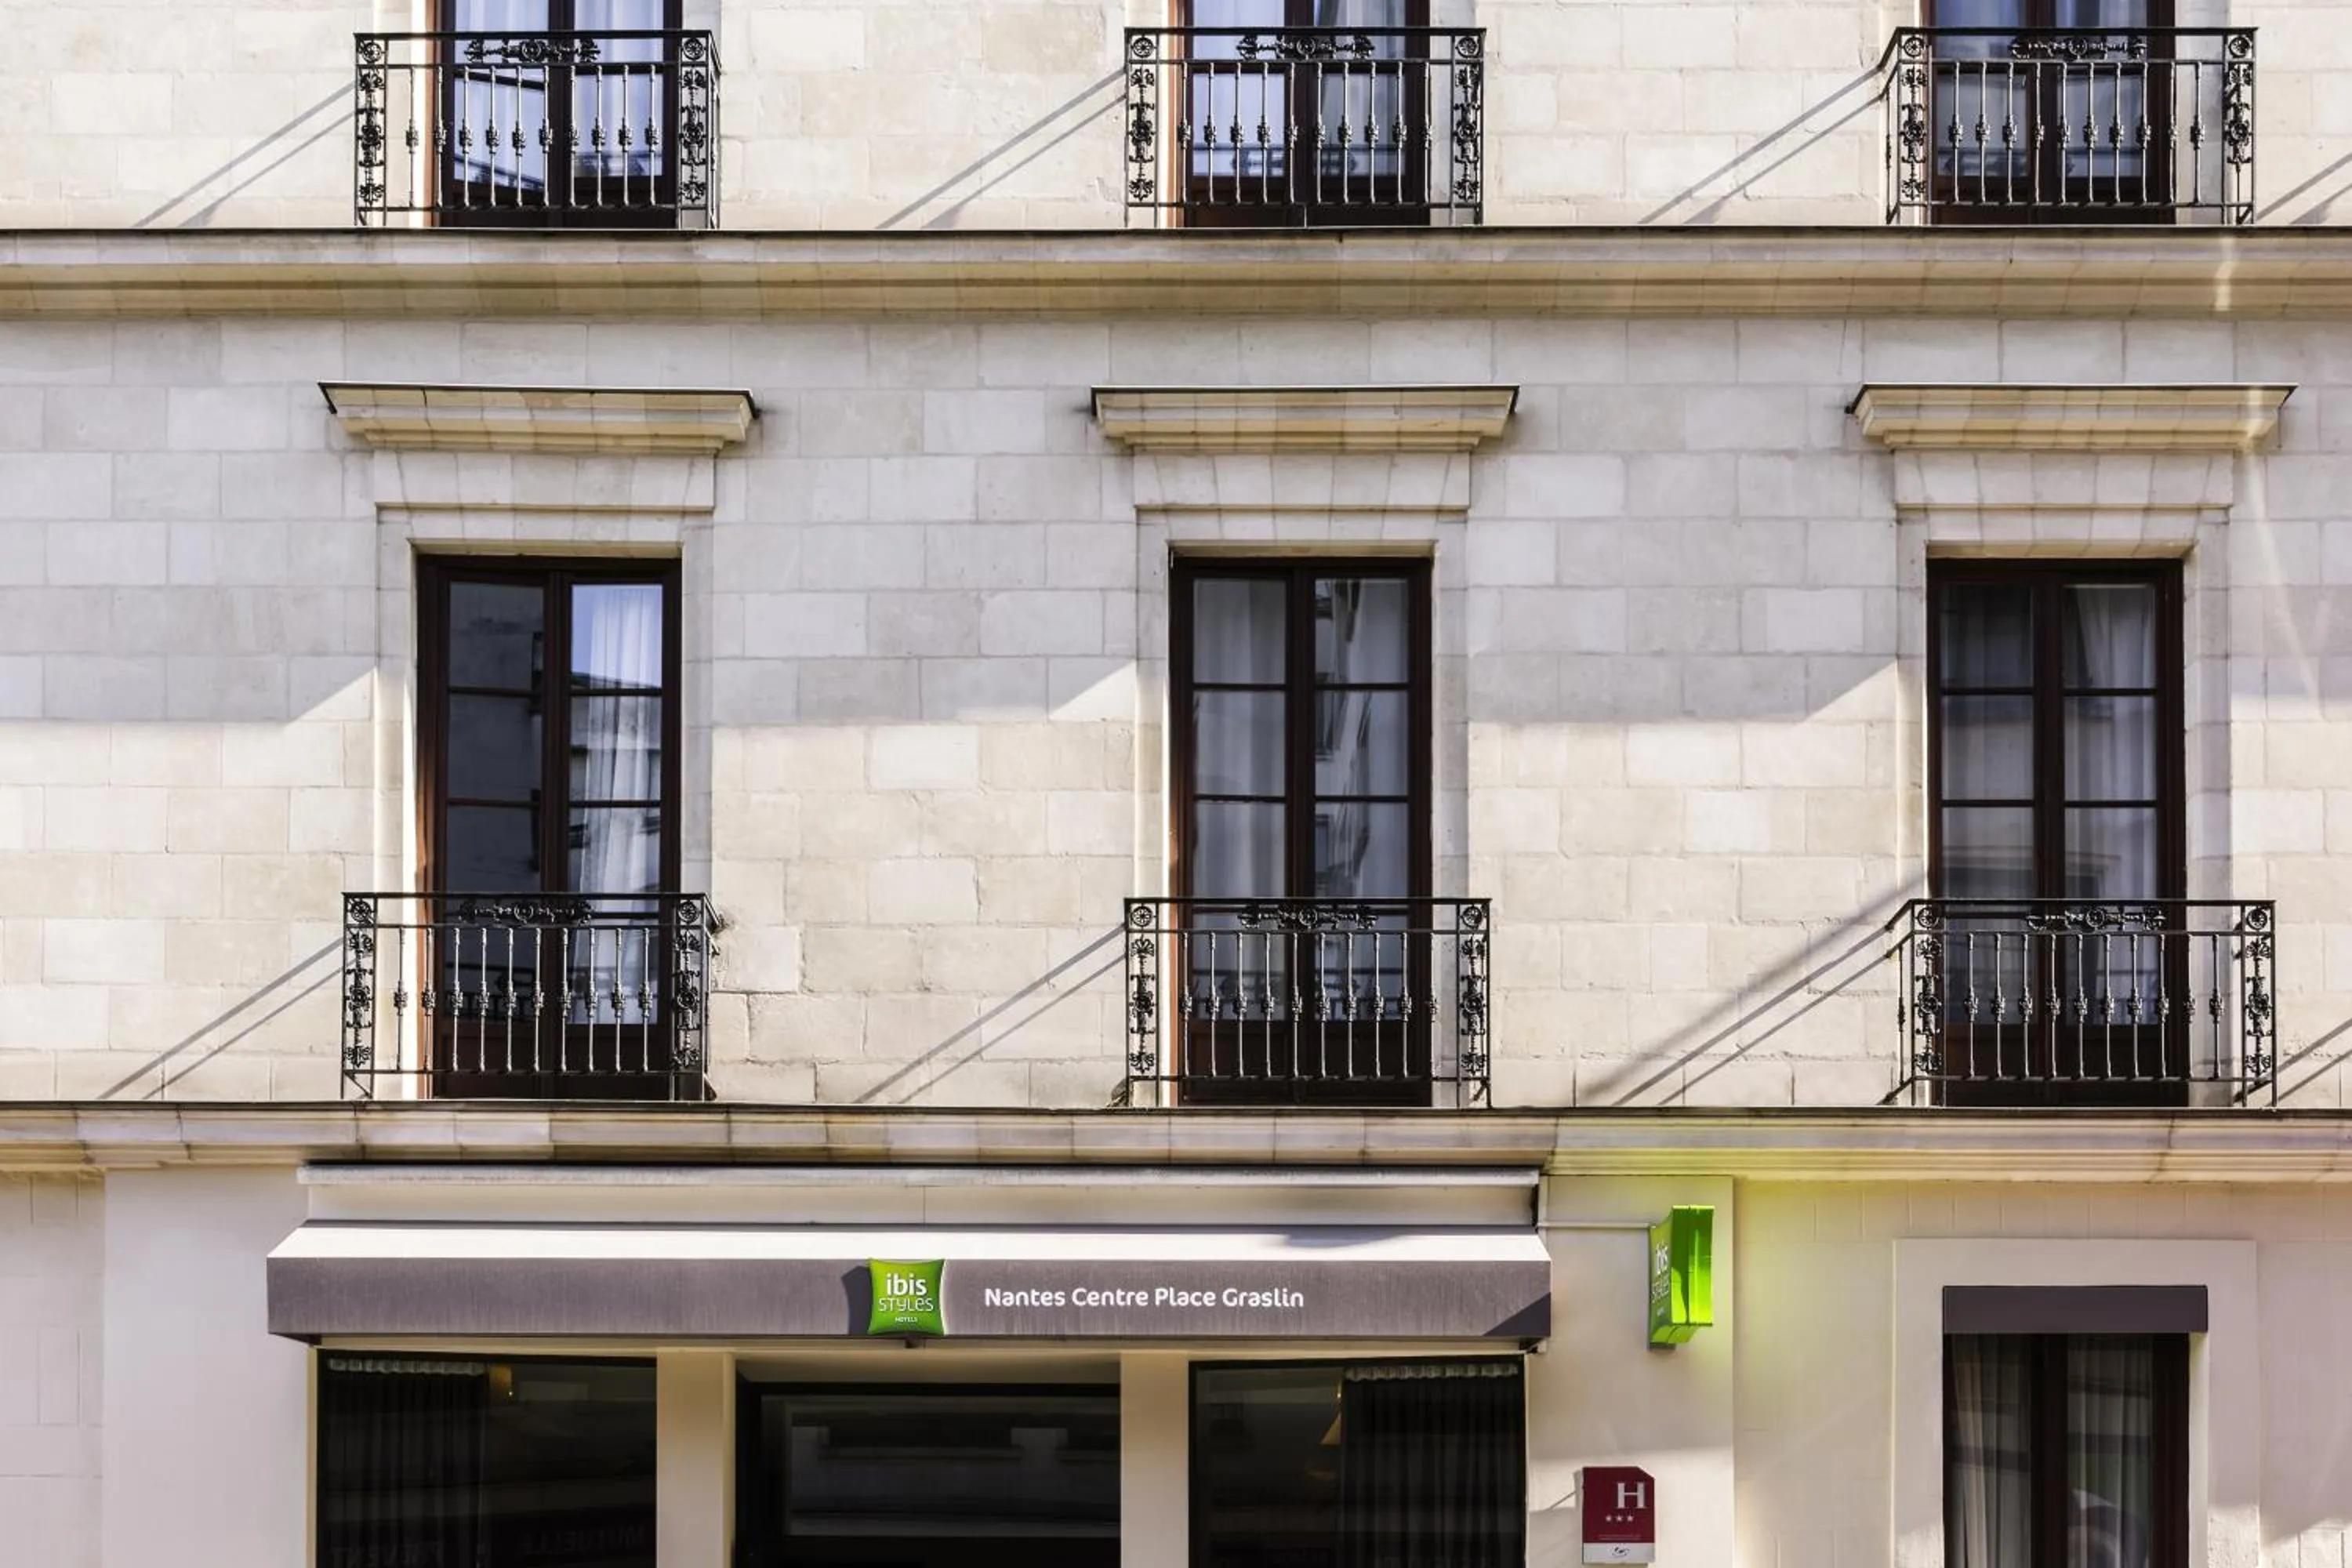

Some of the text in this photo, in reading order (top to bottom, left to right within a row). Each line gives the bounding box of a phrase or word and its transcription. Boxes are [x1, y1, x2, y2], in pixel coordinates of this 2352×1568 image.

[886, 1272, 927, 1296] ibis
[984, 1287, 1305, 1308] Nantes Centre Place Graslin
[1617, 1482, 1645, 1508] H
